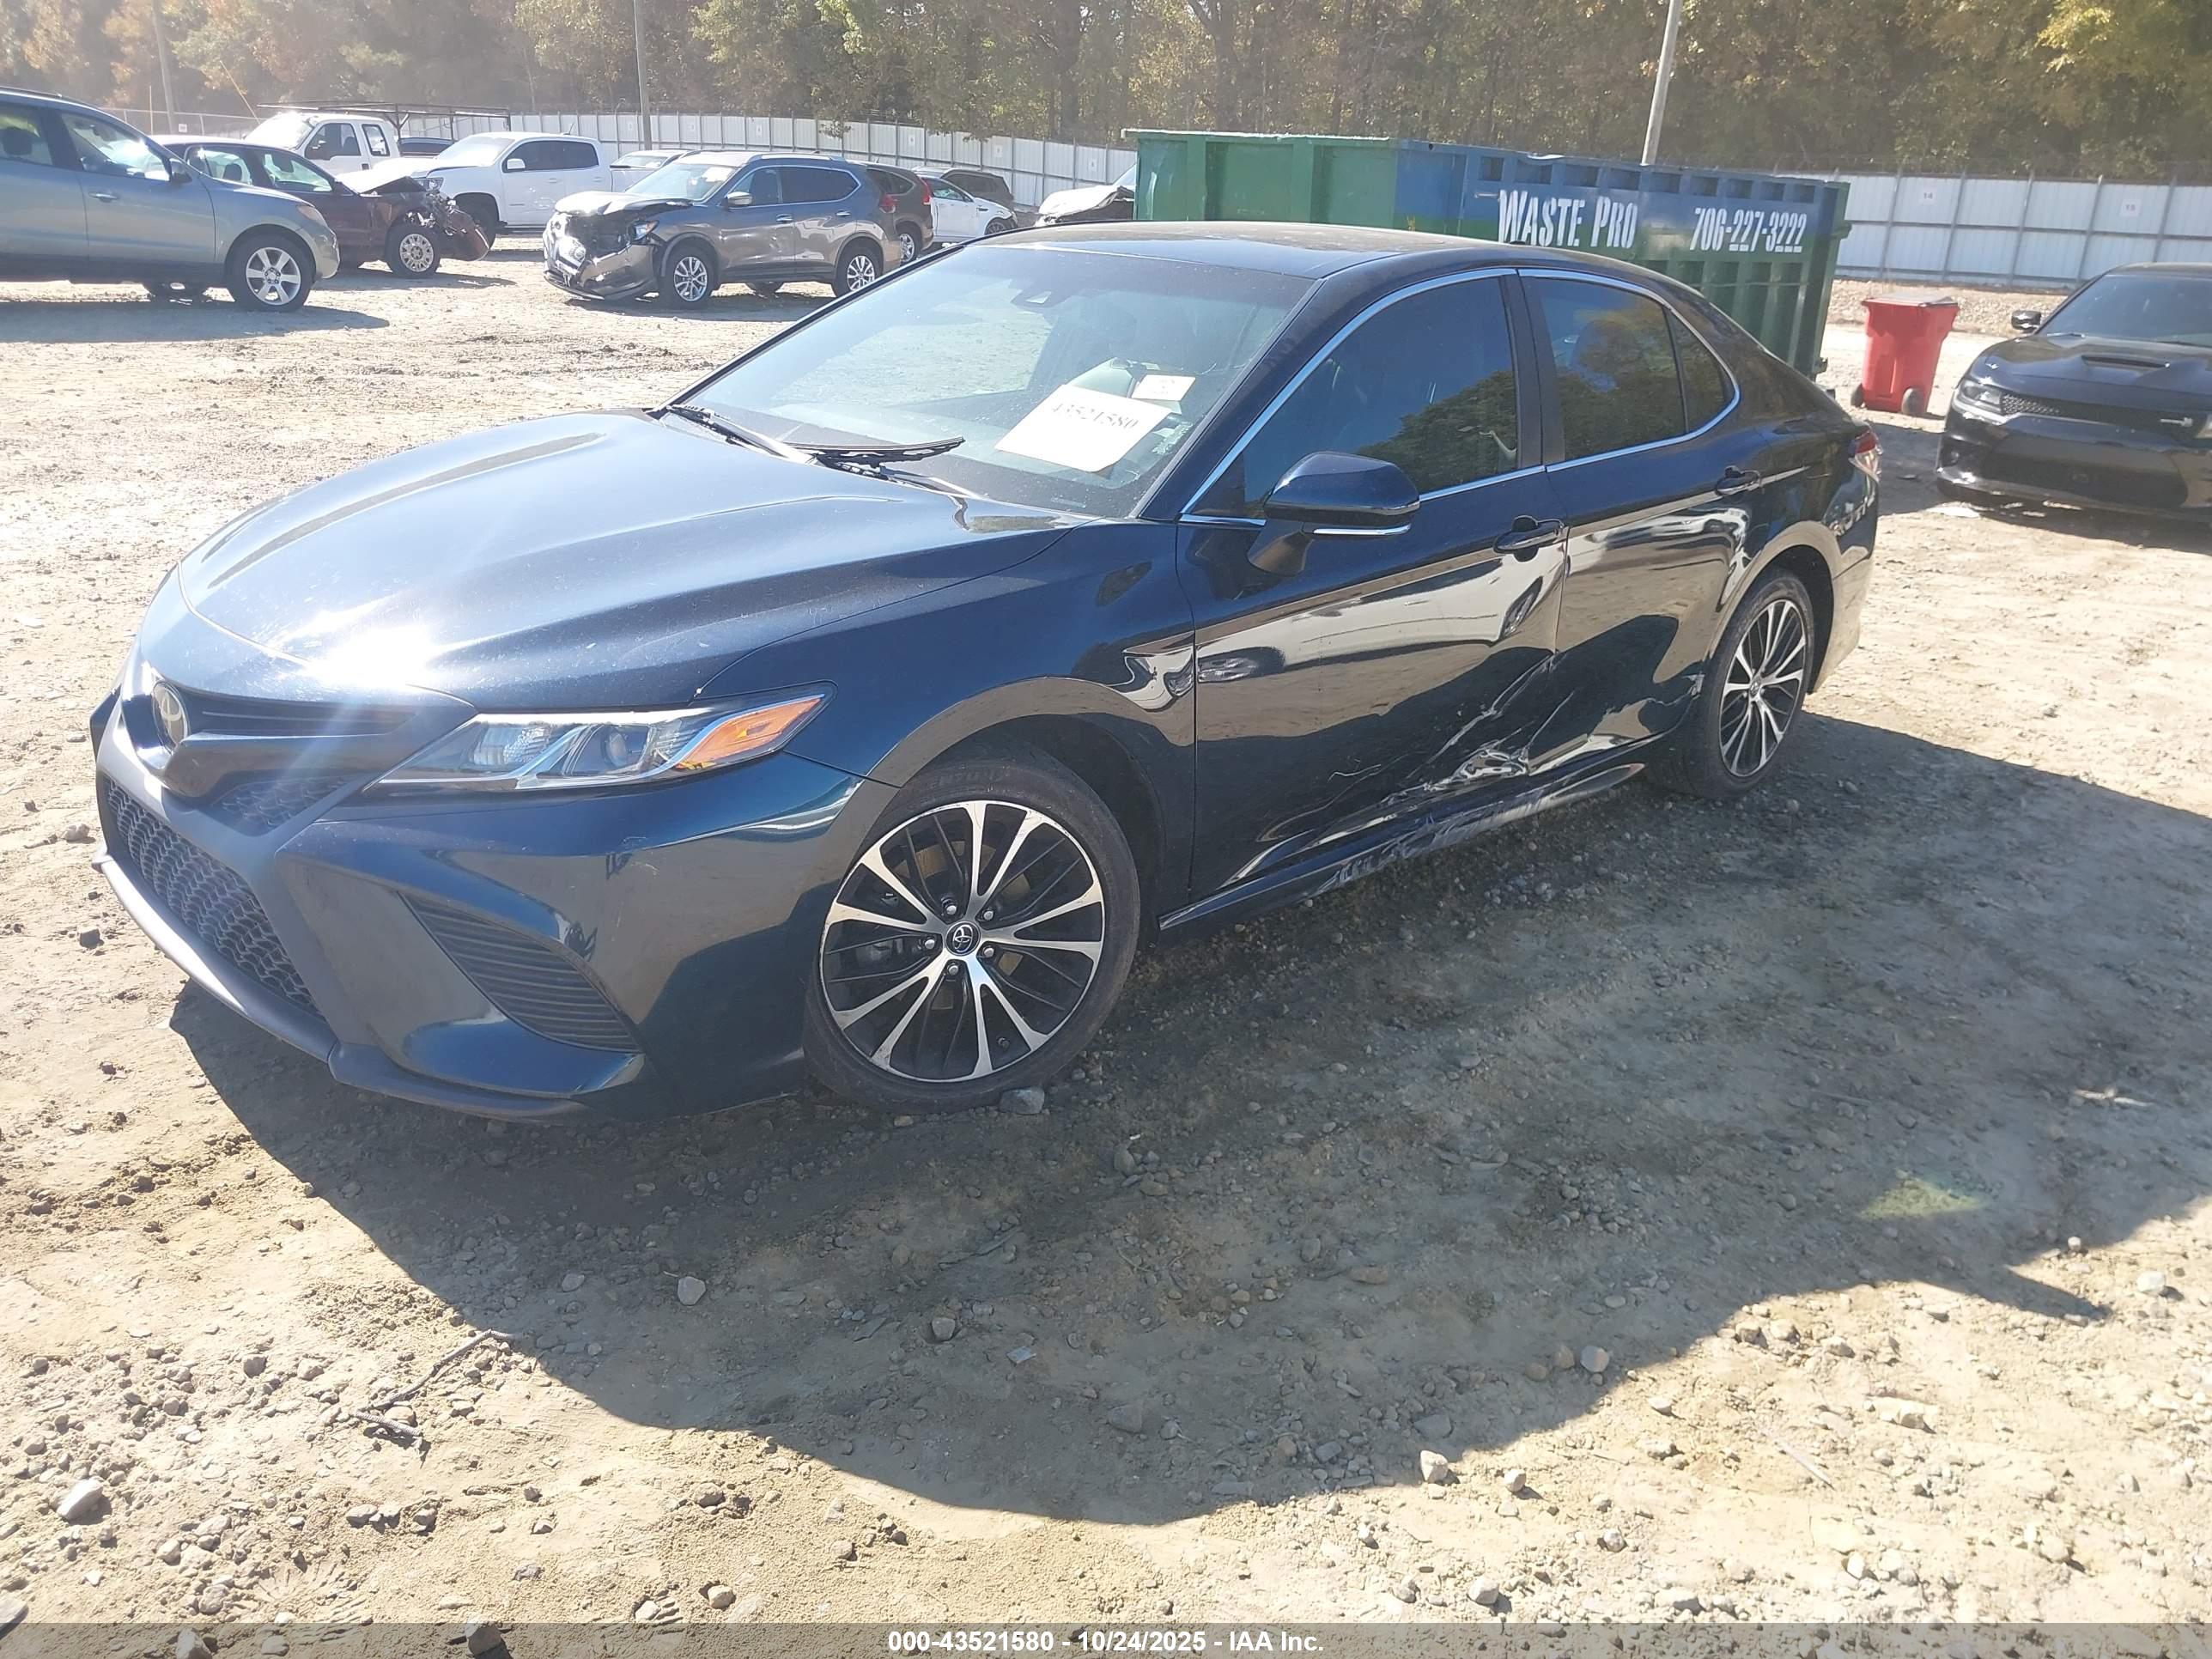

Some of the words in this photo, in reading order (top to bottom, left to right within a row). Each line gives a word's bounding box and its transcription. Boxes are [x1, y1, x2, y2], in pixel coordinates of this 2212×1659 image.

[1498, 189, 1585, 247] WASTE
[1589, 195, 1638, 249] PRO
[1689, 207, 1808, 253] 706-227-3222
